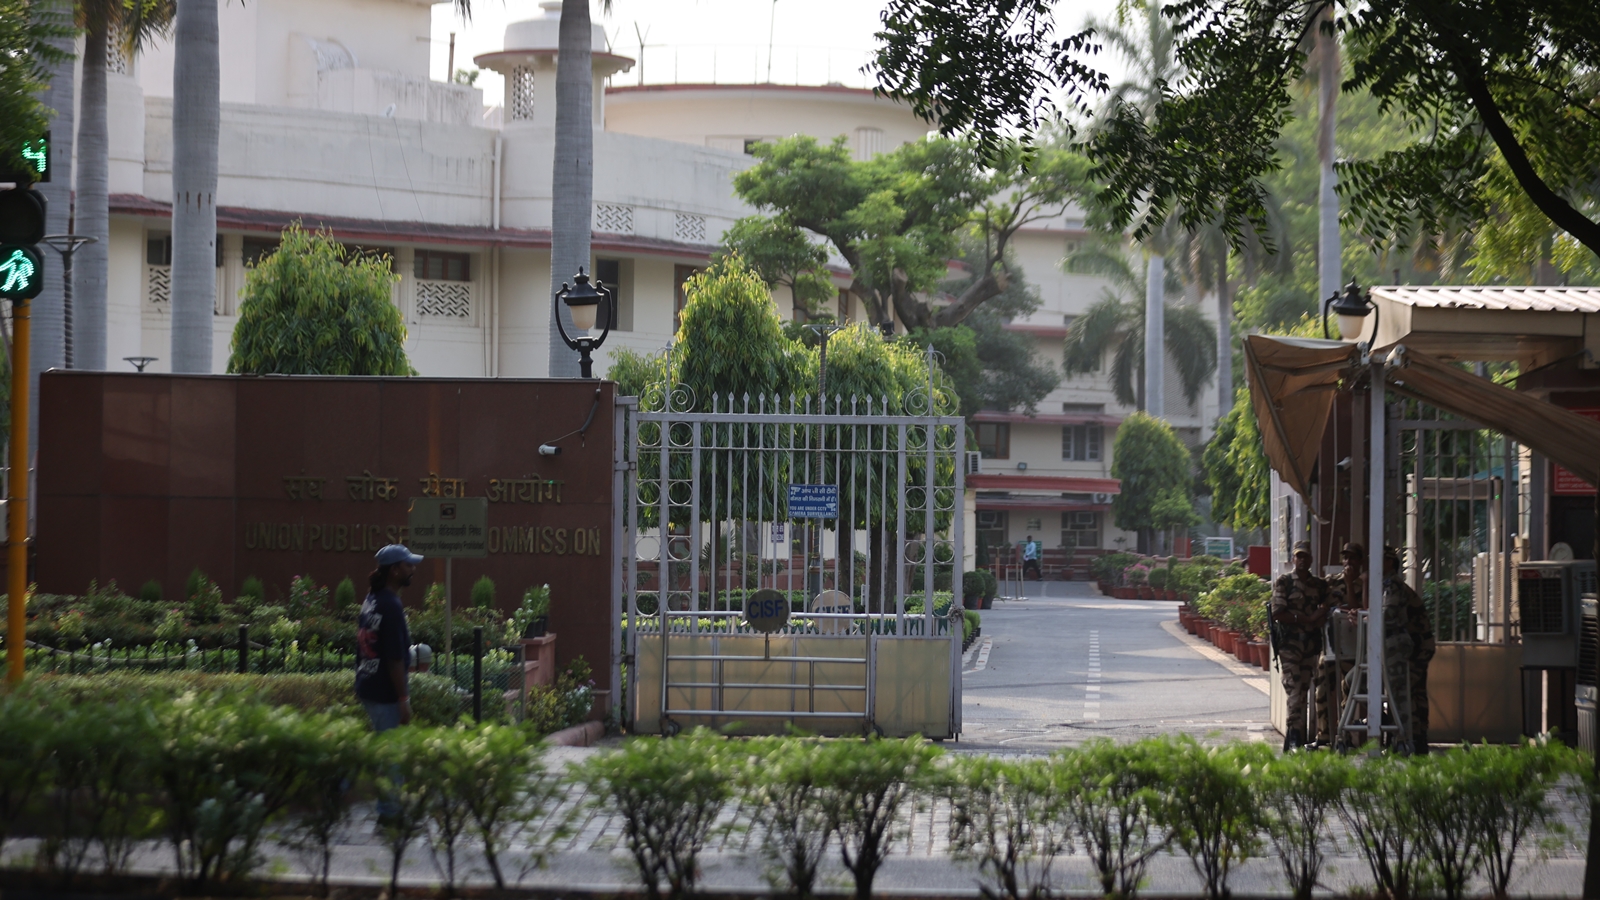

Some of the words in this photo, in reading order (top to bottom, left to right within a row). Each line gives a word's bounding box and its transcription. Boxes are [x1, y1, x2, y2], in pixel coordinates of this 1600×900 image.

[22, 139, 46, 172] 4
[345, 469, 399, 501] लोक
[419, 471, 467, 498] सेवा
[485, 473, 565, 503] आयोग
[246, 522, 304, 551] UNION
[308, 524, 380, 552] PUBLIC
[748, 600, 784, 619] CISF
